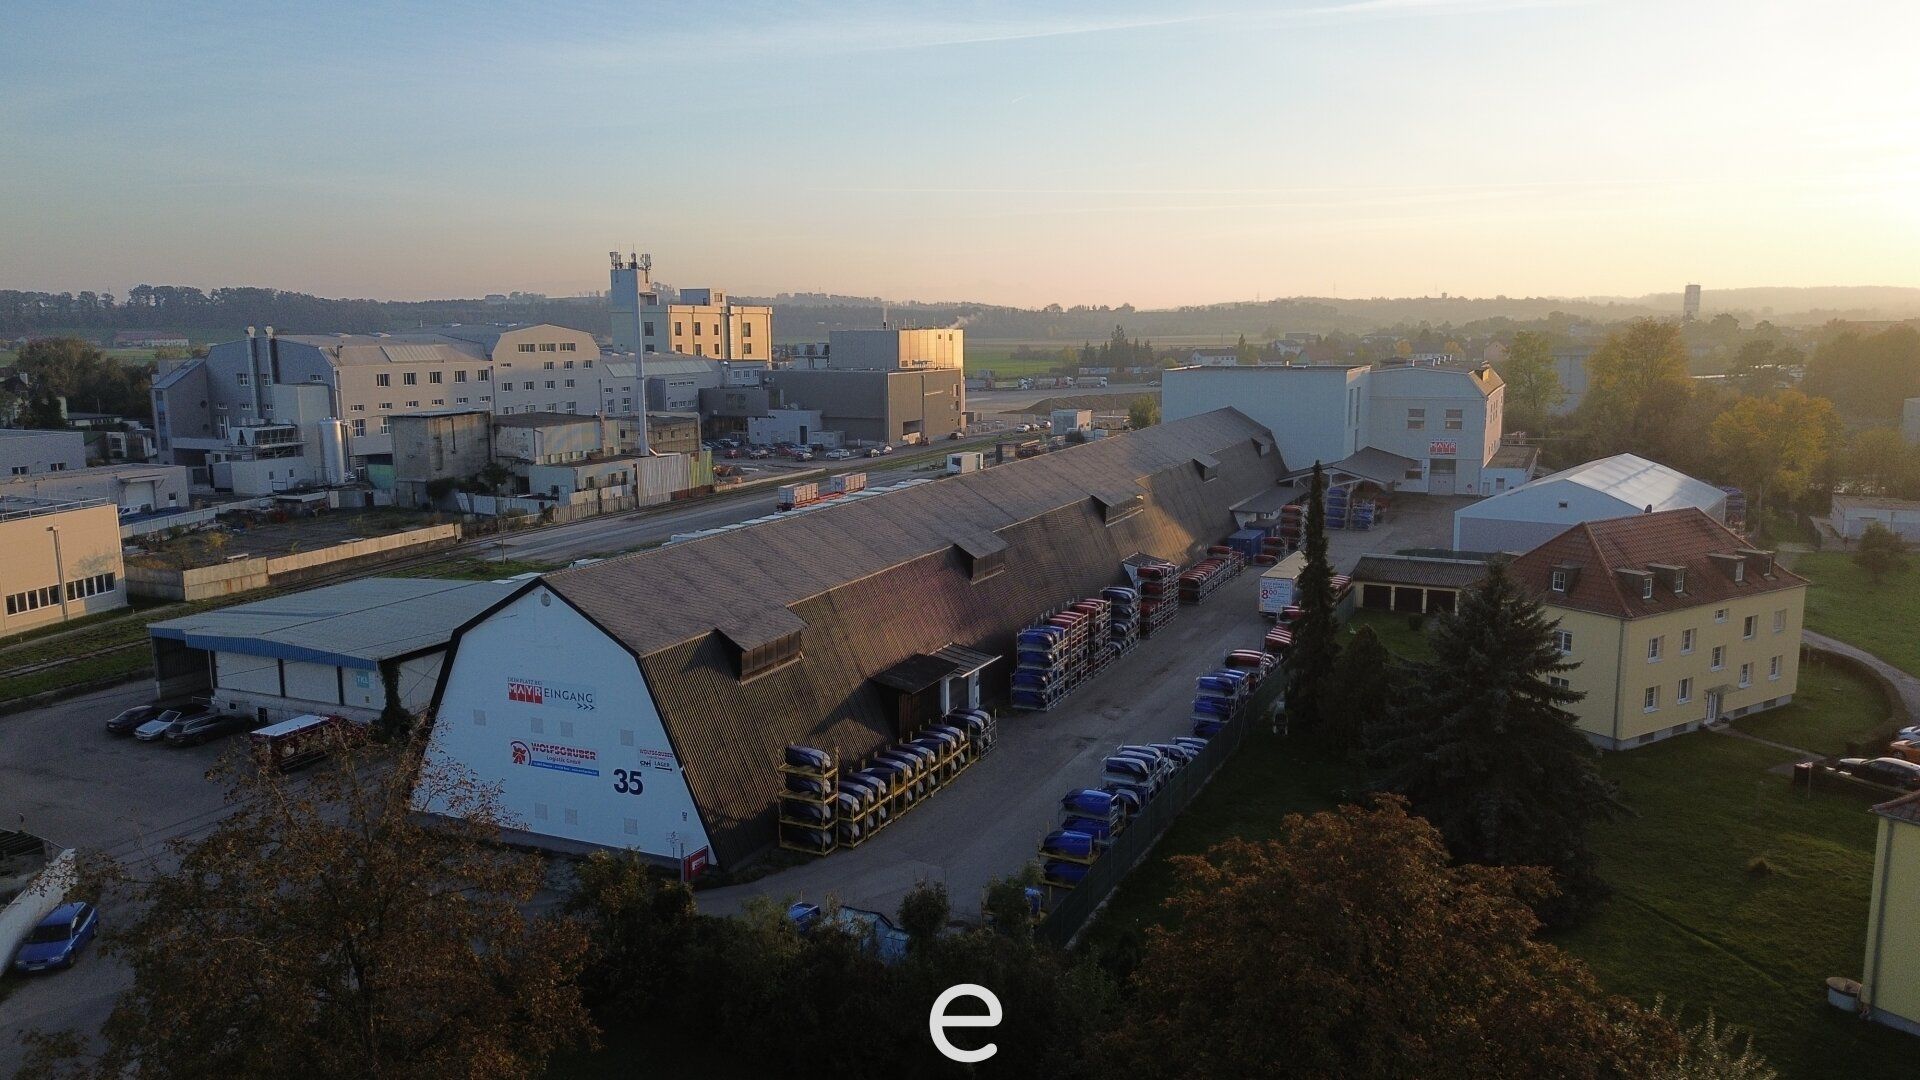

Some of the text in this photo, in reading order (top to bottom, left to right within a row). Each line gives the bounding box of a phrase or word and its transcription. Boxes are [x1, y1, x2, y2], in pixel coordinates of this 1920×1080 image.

[509, 684, 593, 703] MAYR EINGANG
[531, 742, 596, 760] WOLFSGRUBER
[613, 769, 643, 795] 35
